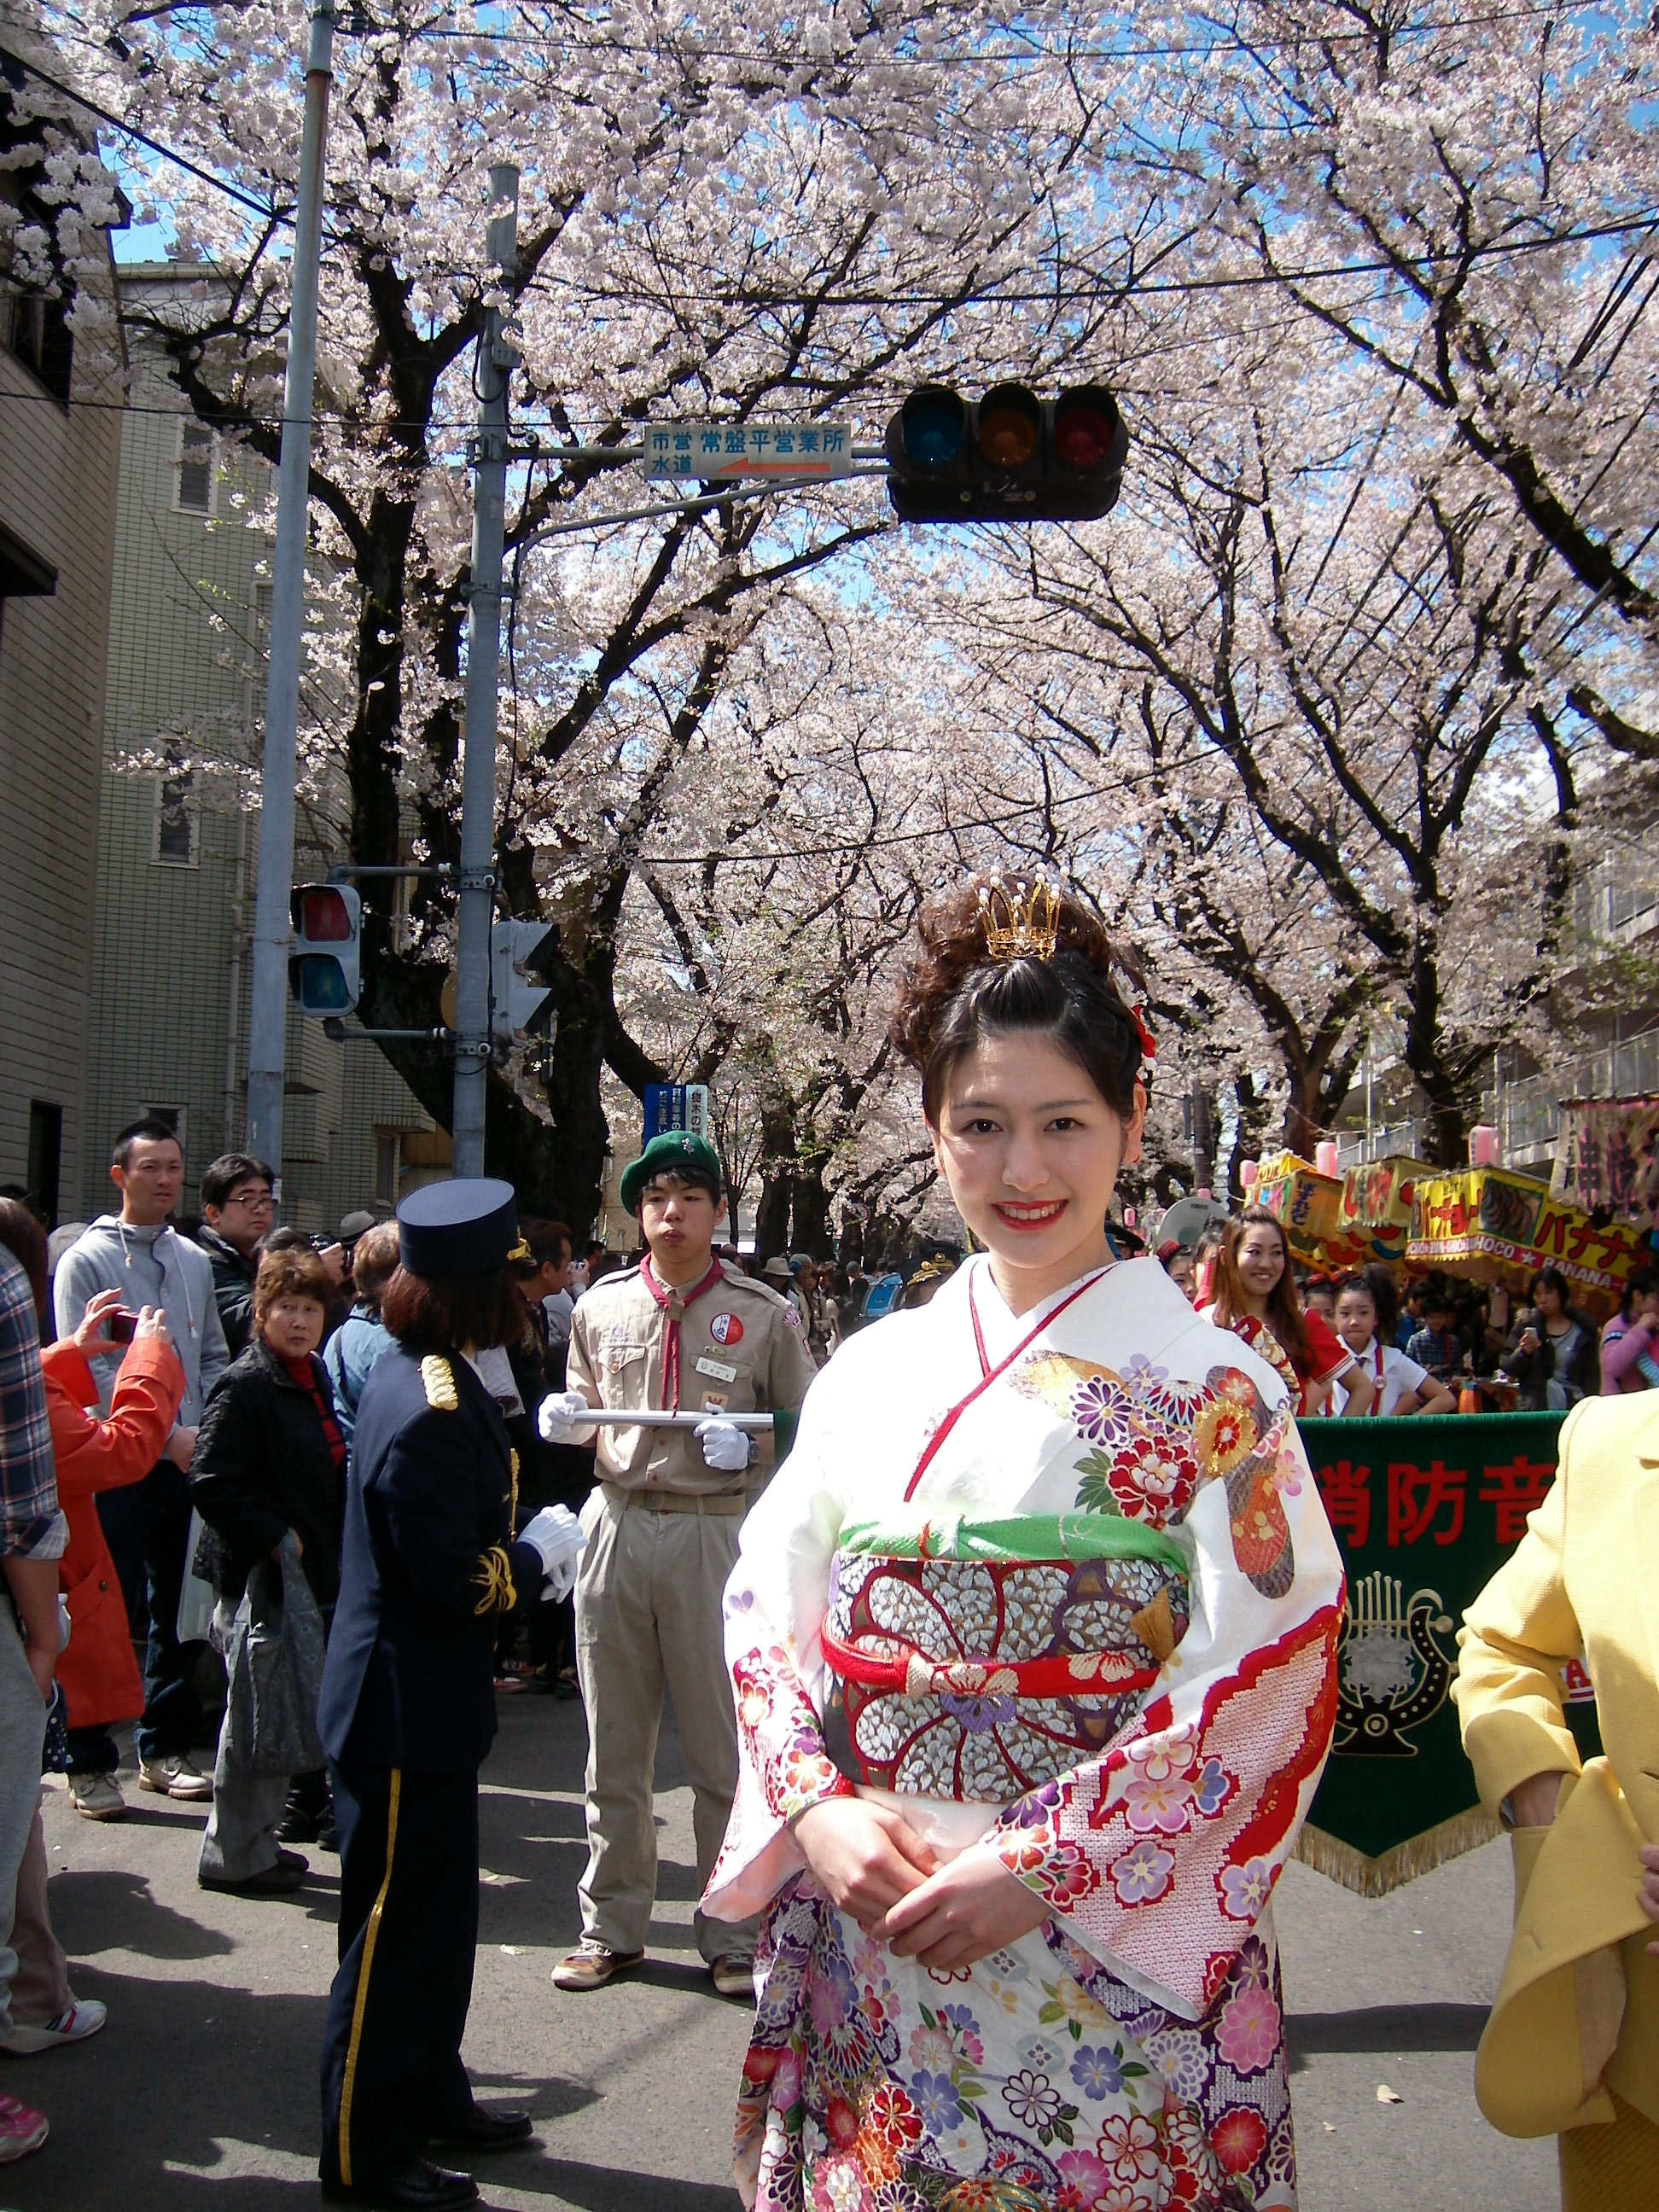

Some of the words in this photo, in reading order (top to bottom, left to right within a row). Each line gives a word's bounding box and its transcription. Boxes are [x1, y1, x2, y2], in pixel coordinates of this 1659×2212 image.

[652, 431, 693, 451] 市営
[701, 429, 845, 454] 常盤平営業所
[651, 454, 693, 474] 水道
